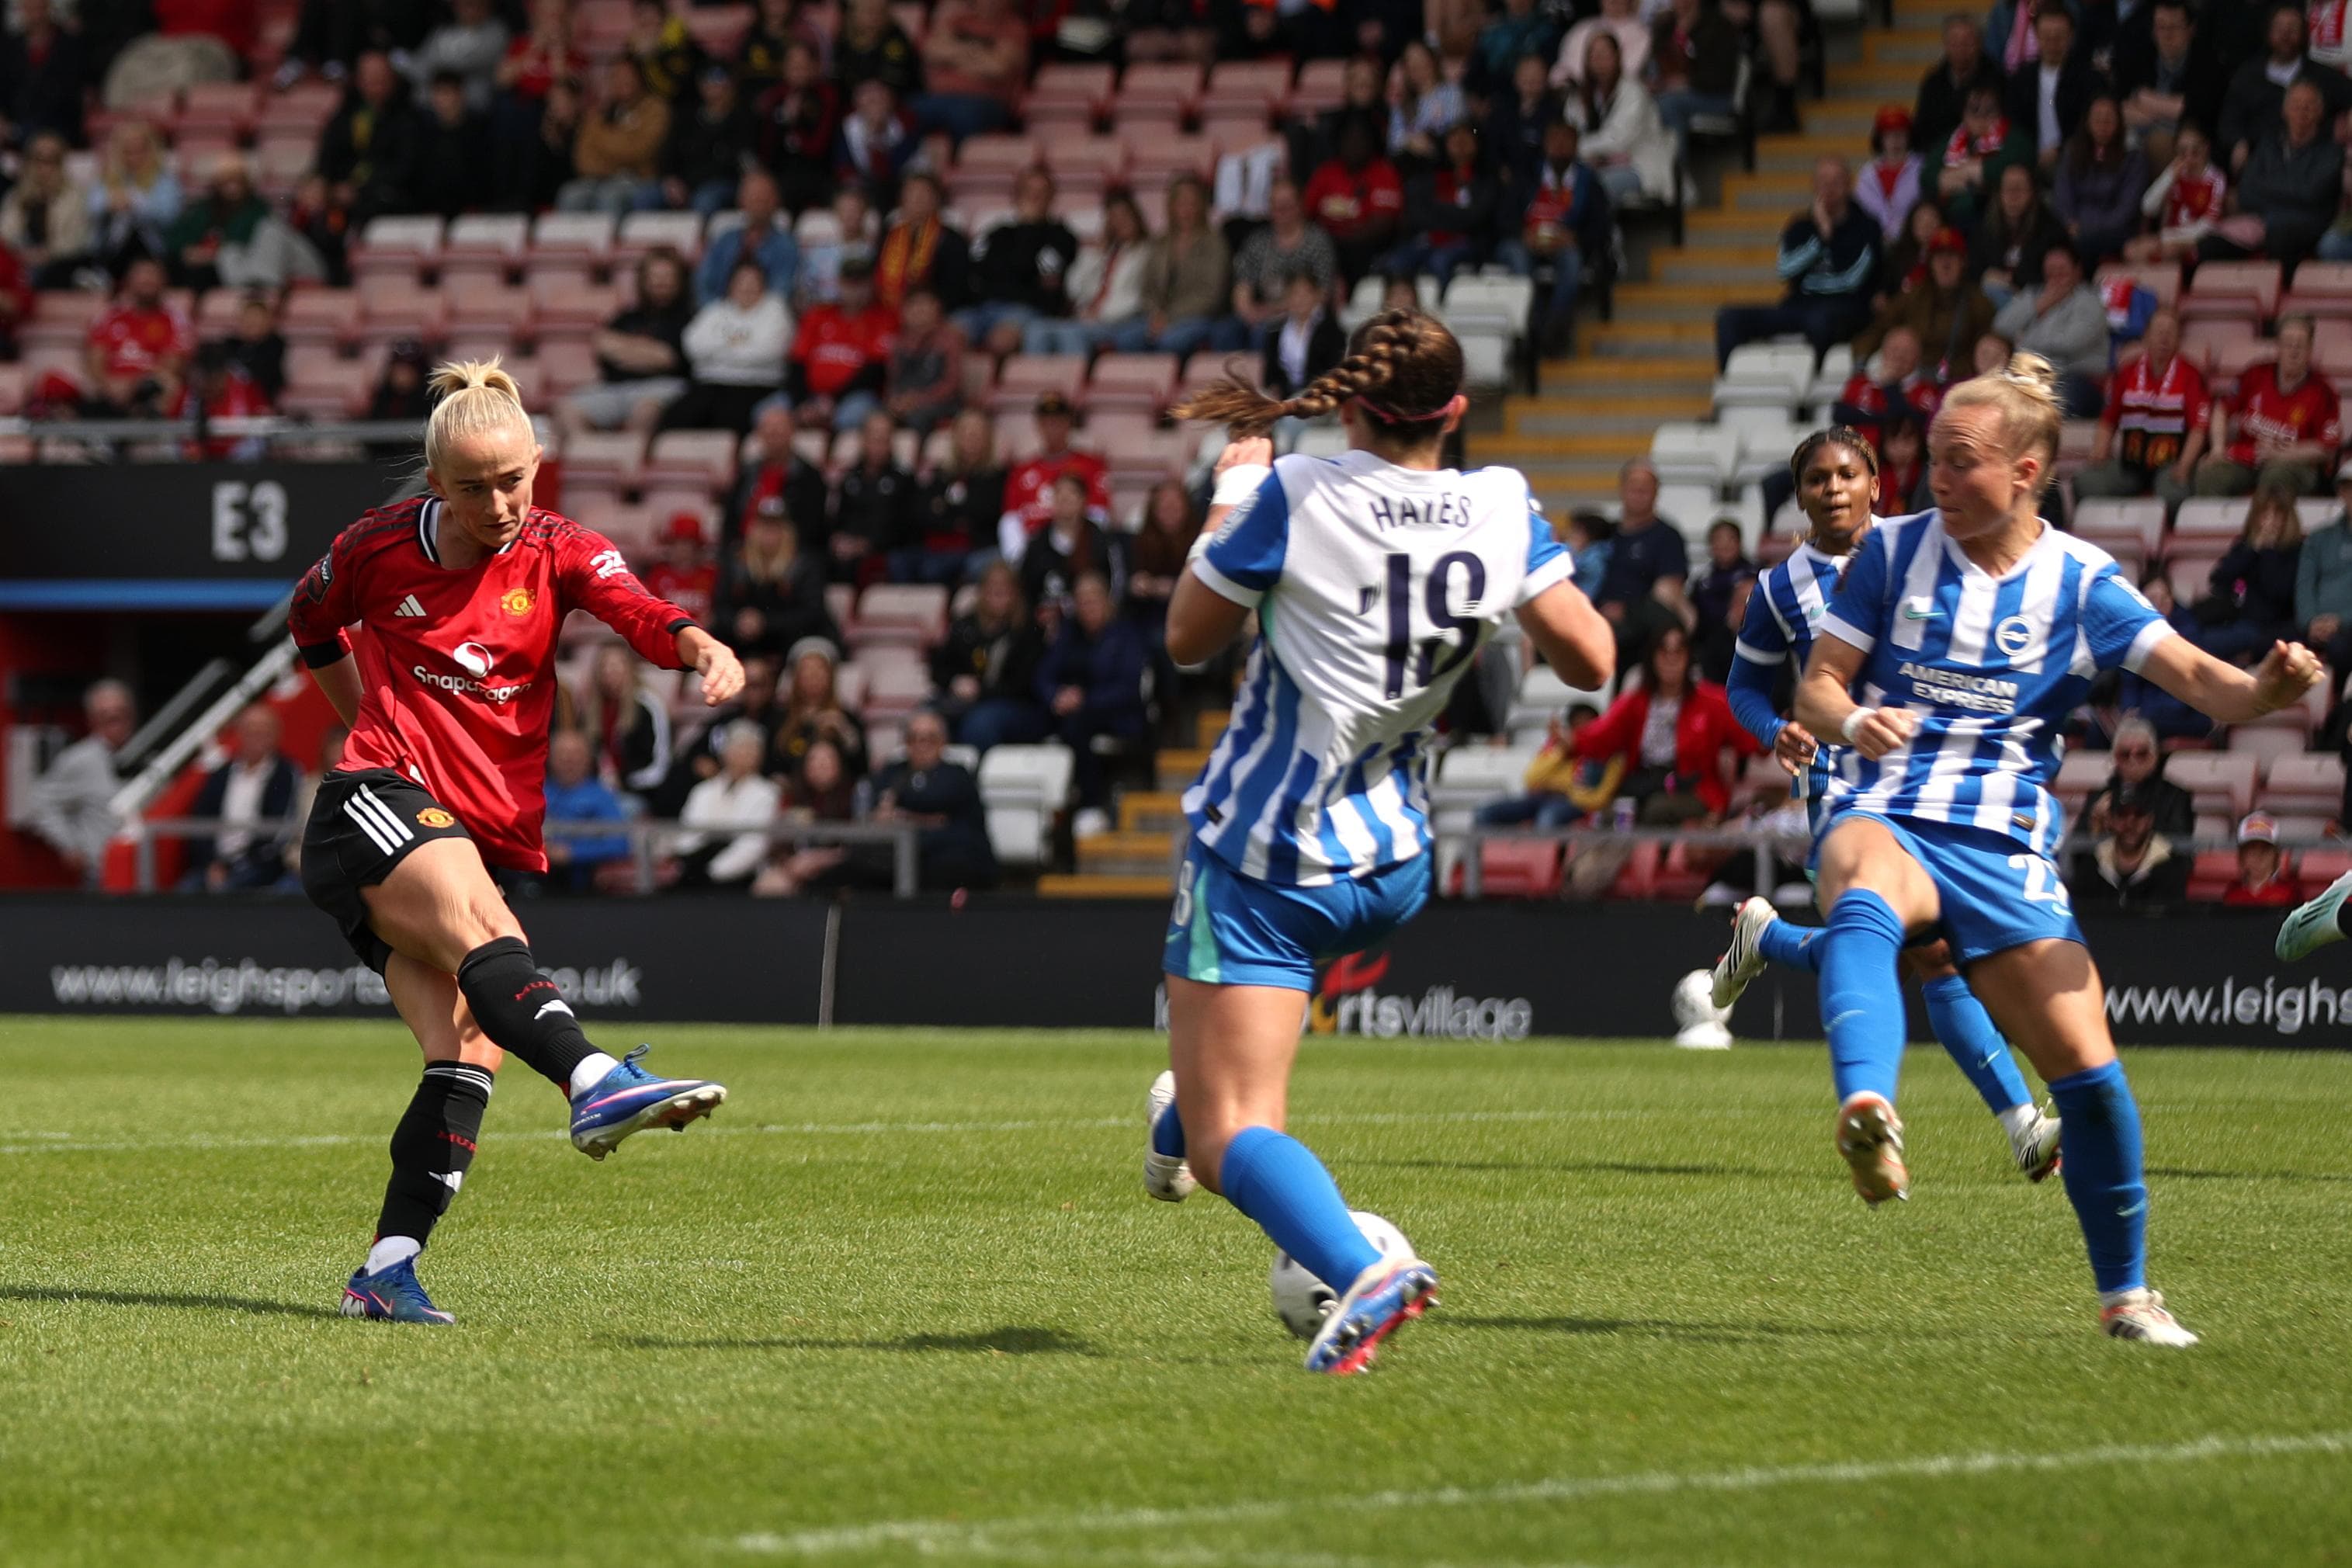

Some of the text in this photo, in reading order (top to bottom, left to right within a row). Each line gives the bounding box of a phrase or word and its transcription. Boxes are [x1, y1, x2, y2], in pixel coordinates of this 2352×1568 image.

[211, 480, 288, 562] E3
[1369, 491, 1471, 532] HAYES
[1898, 661, 2018, 698] AMERICAN
[1912, 681, 2016, 715] EXPRESS
